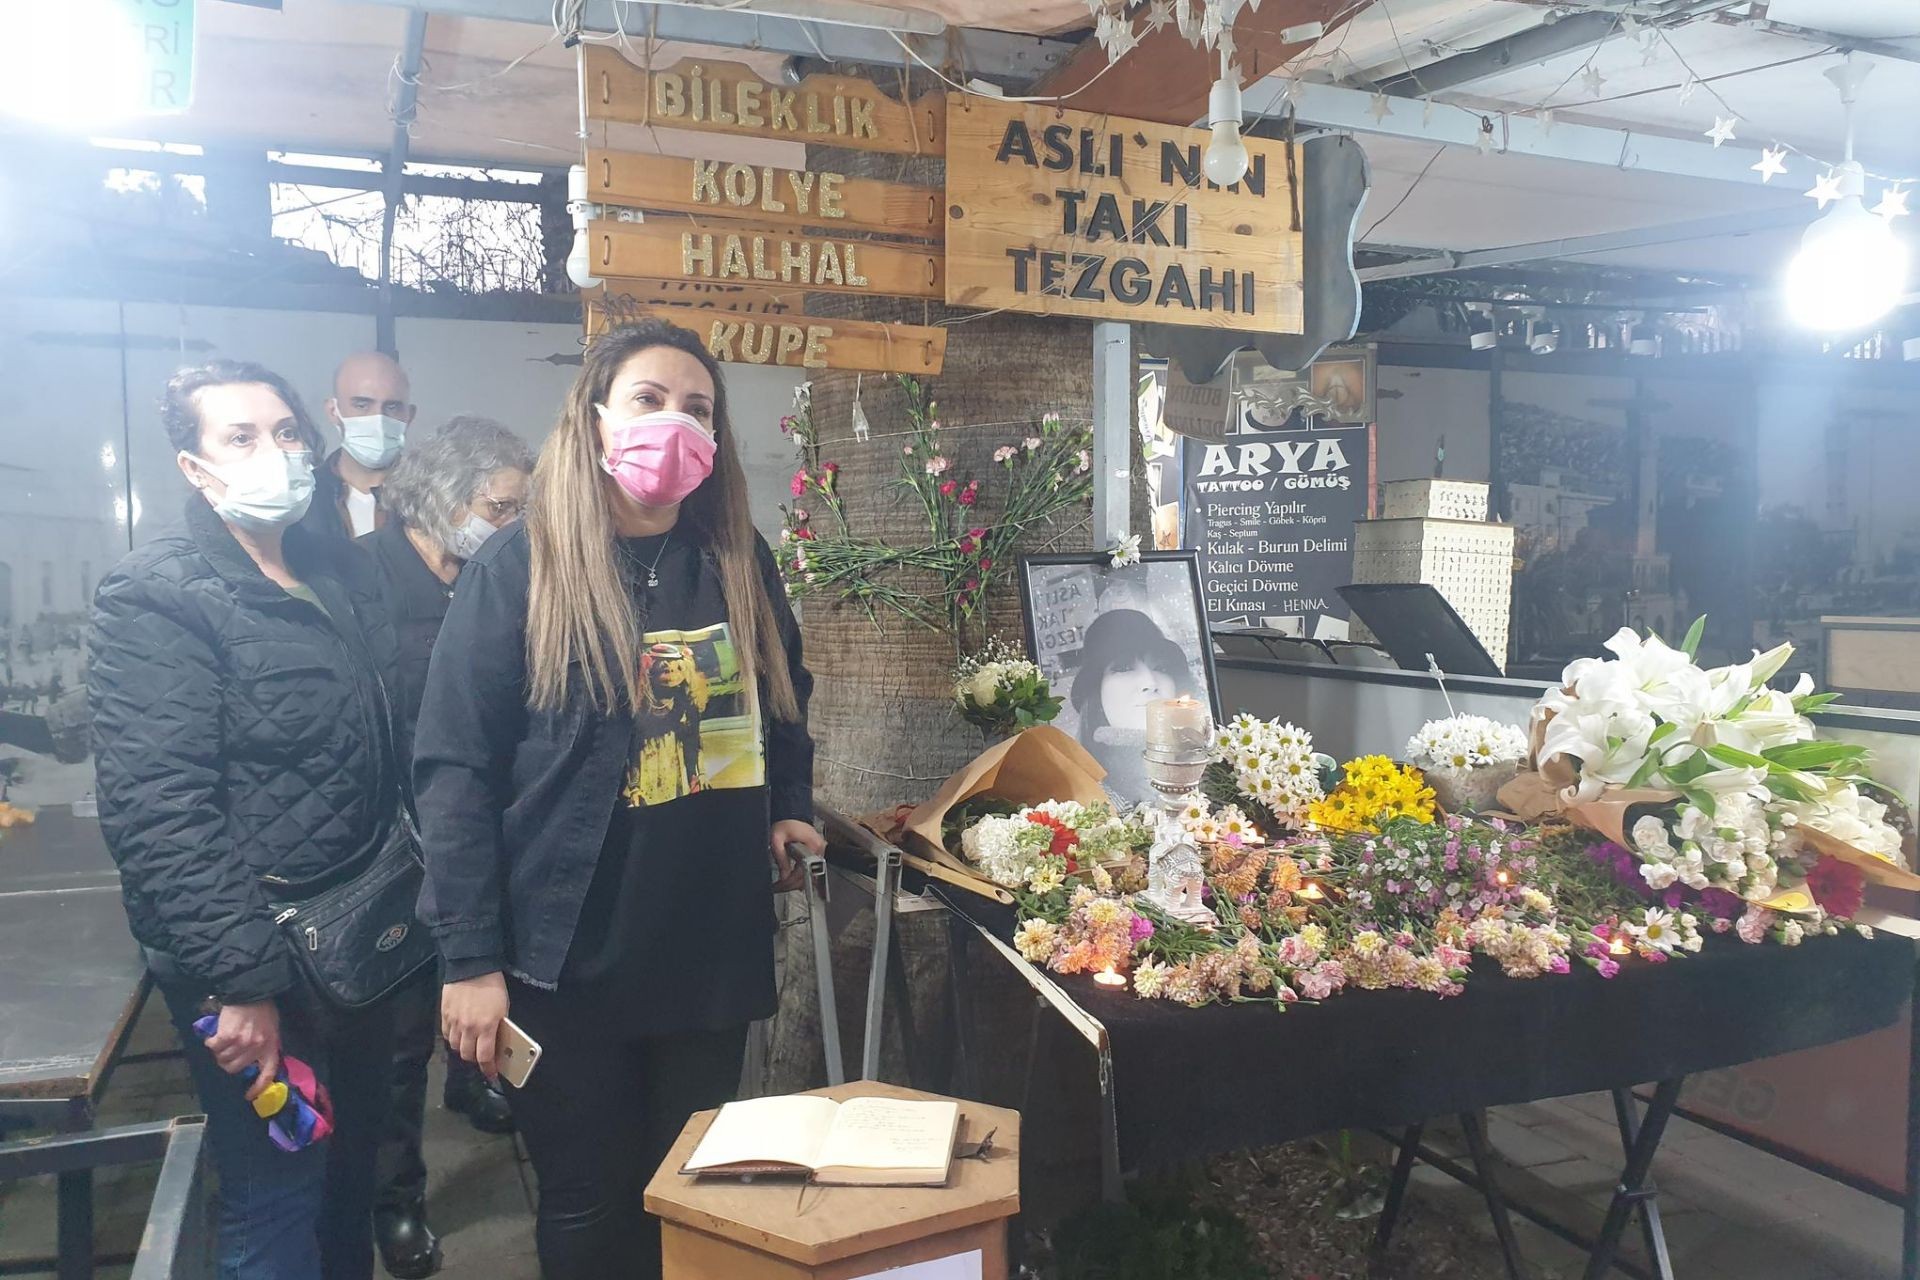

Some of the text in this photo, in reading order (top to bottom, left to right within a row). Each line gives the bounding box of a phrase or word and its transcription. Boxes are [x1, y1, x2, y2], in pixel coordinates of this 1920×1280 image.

[655, 65, 878, 139] BİLEKLİK
[692, 159, 846, 218] KOLYE
[1055, 187, 1188, 249] TAKI
[681, 231, 869, 287] HALHAL
[1005, 248, 1255, 316] TEZGAHI
[1196, 438, 1352, 478] ARYA
[1196, 479, 1265, 494] TATTOO
[1207, 500, 1306, 519] Piercing Yapılır
[1268, 515, 1295, 525] Göbek
[1302, 515, 1327, 526] Köprü
[1229, 528, 1259, 539] Septum
[1207, 541, 1245, 555] Kulak
[1258, 540, 1300, 554] Burun
[1303, 538, 1347, 553] Delimi
[1207, 559, 1294, 574] Kalıcı Dövme
[1207, 578, 1299, 595] Geçici Dövme
[1207, 598, 1222, 612] El
[1226, 598, 1266, 612] Kınası
[1283, 598, 1330, 613] HENNA
